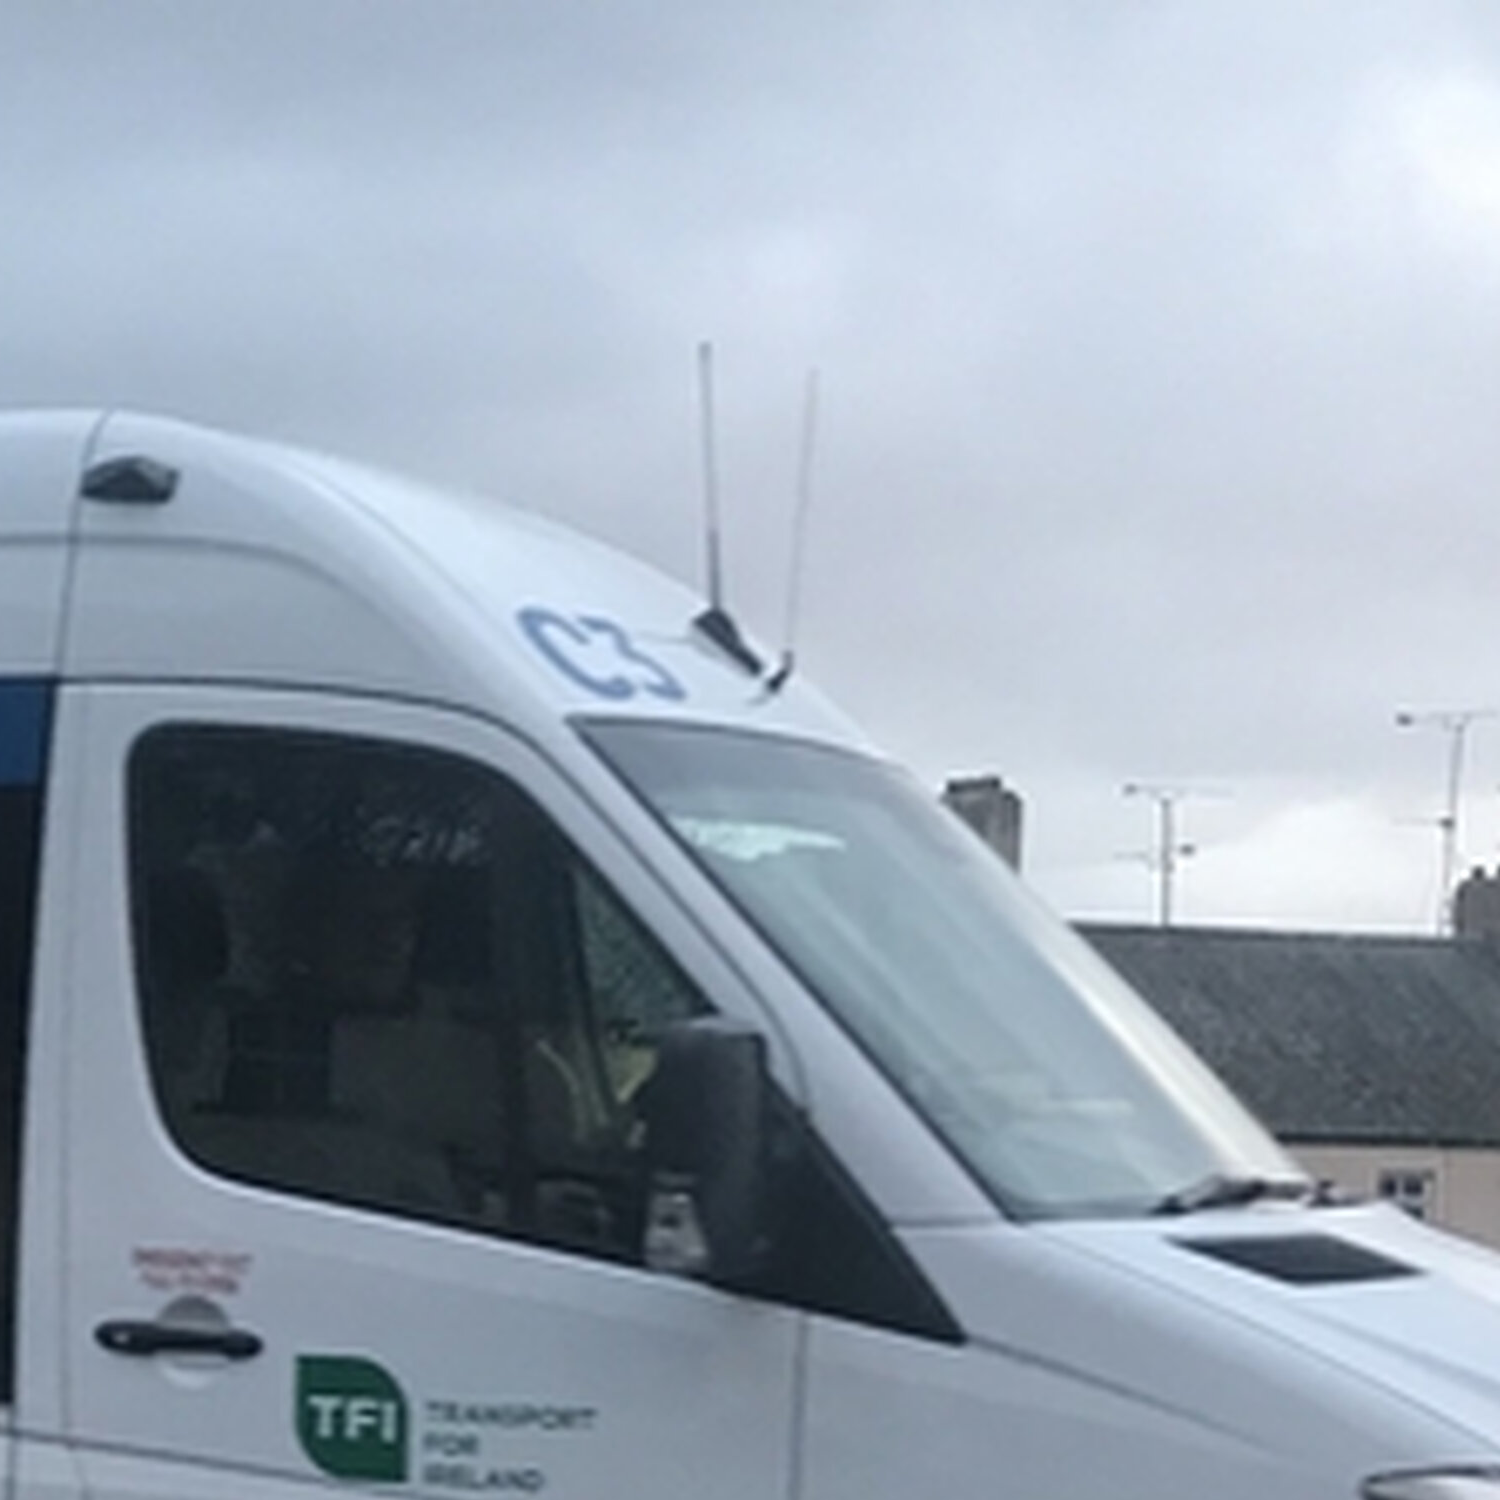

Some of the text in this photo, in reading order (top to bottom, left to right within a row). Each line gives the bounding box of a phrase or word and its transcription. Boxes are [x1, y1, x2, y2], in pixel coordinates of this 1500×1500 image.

[516, 607, 688, 702] C3
[308, 1394, 397, 1444] TFI
[425, 1400, 596, 1431] TRANSPORT
[423, 1431, 479, 1457] FOR
[423, 1463, 545, 1494] IRELAND
